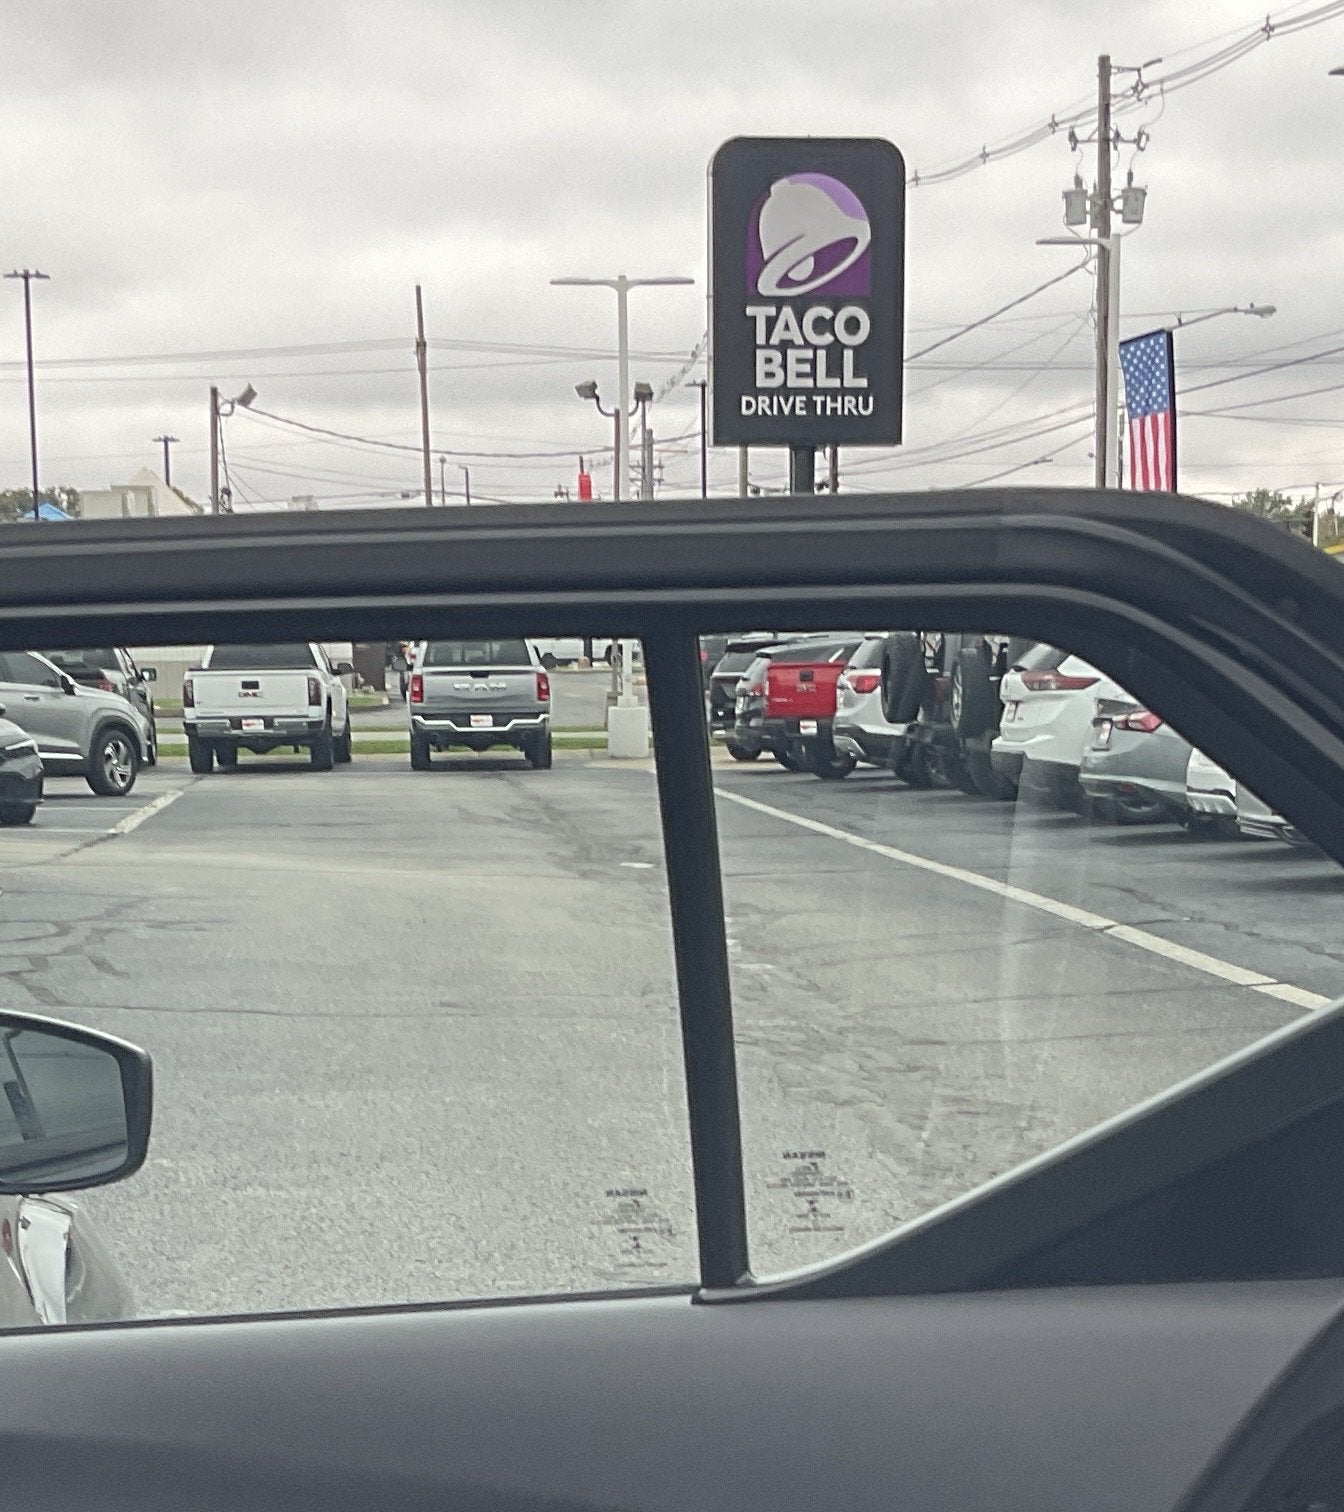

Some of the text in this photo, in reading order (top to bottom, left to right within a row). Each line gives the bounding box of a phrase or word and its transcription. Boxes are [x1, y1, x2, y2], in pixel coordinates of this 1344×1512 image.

[746, 306, 871, 346] TACO
[756, 349, 868, 389] BELL
[741, 396, 874, 416] DRIVE THRU
